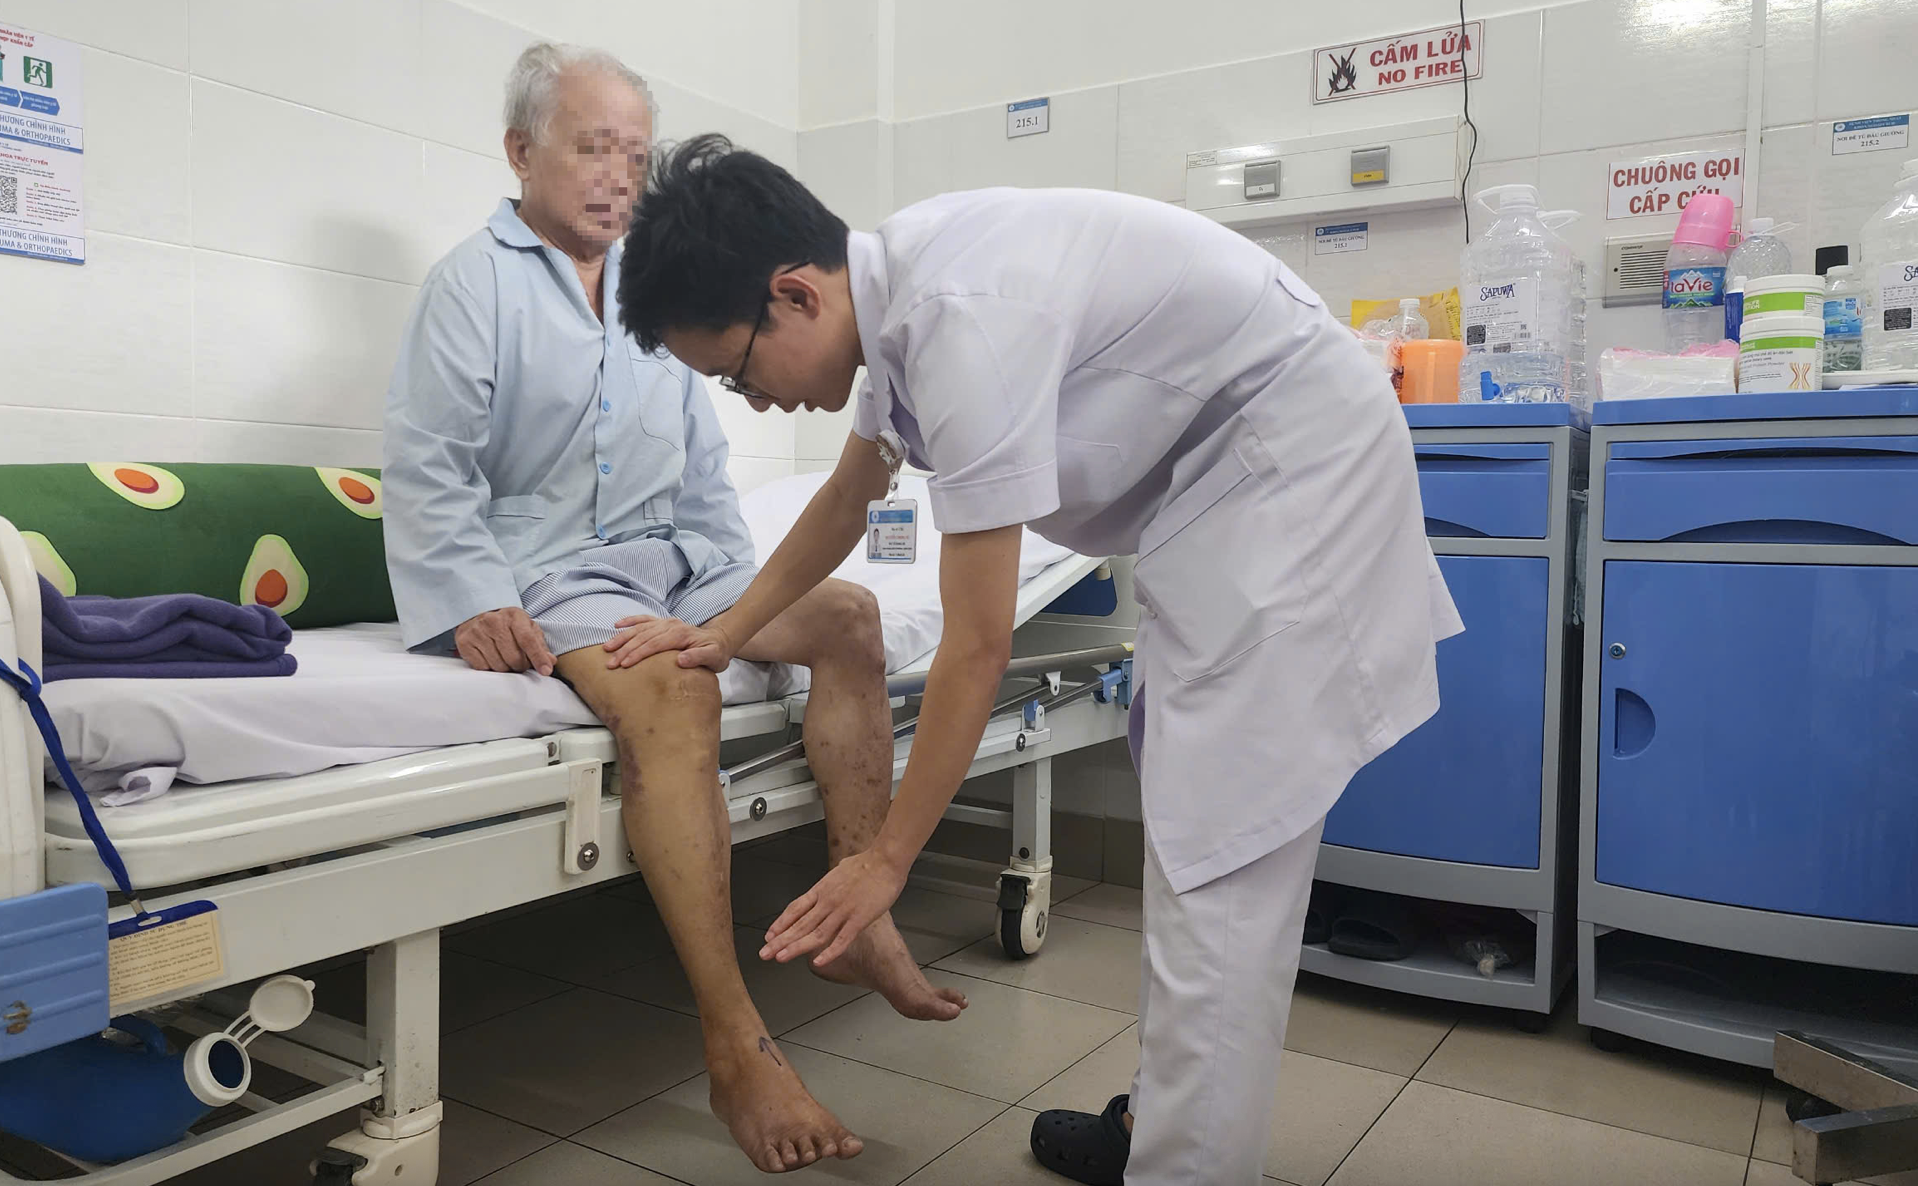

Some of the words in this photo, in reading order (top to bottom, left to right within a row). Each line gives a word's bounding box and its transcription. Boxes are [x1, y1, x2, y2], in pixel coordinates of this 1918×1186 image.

[1370, 40, 1418, 67] CẤM
[1427, 31, 1472, 57] LỬA
[1378, 69, 1406, 86] NO
[1414, 59, 1464, 80] FIRE
[1016, 116, 1039, 128] 215.1
[21, 129, 71, 145] ORTHOPAEDICS
[1613, 161, 1697, 187] CHUÔNG
[1703, 157, 1740, 181] GỌI
[1629, 186, 1671, 214] CẤP
[23, 242, 73, 257] ORTHOPAEDICS
[1480, 284, 1515, 301] SAPUWA
